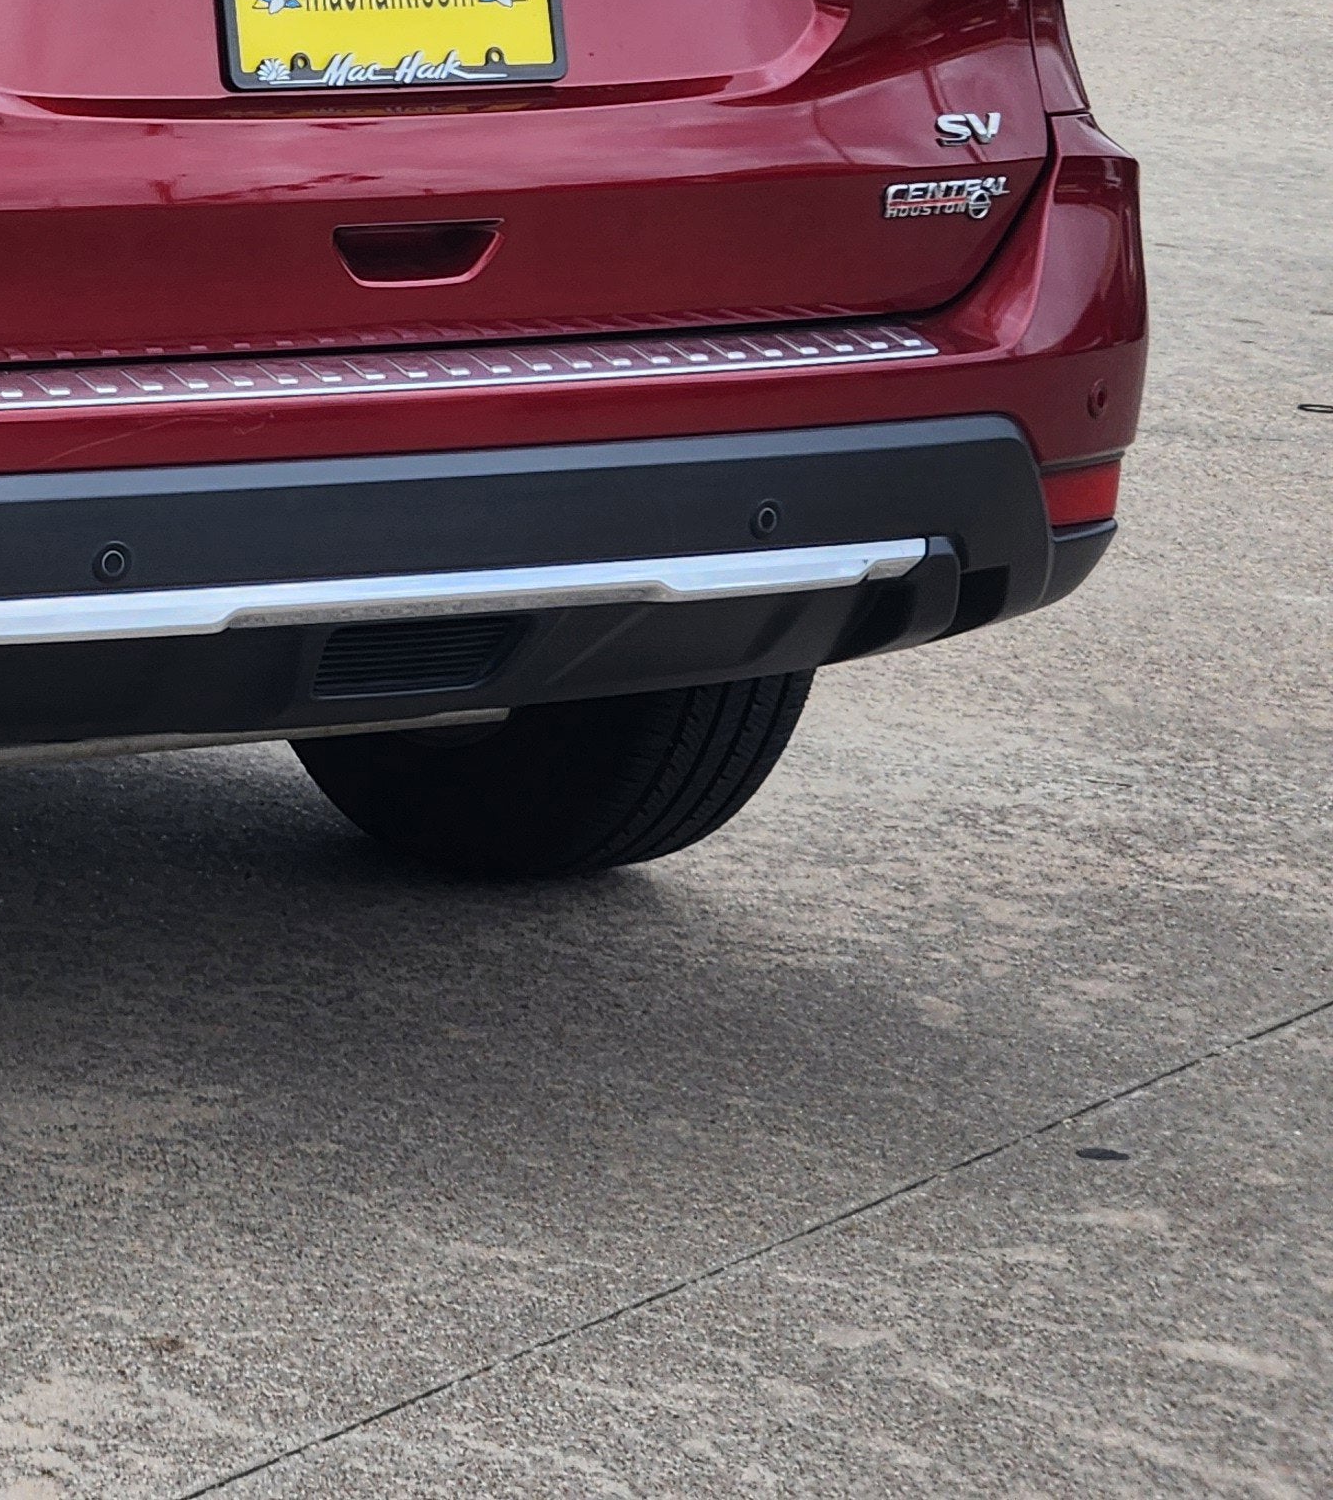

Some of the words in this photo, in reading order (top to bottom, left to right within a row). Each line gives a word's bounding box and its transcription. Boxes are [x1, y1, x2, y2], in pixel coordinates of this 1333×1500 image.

[317, 52, 393, 86] Mac
[394, 50, 477, 84] Haik
[935, 112, 1001, 147] SV
[885, 202, 966, 218] HOUSTON
